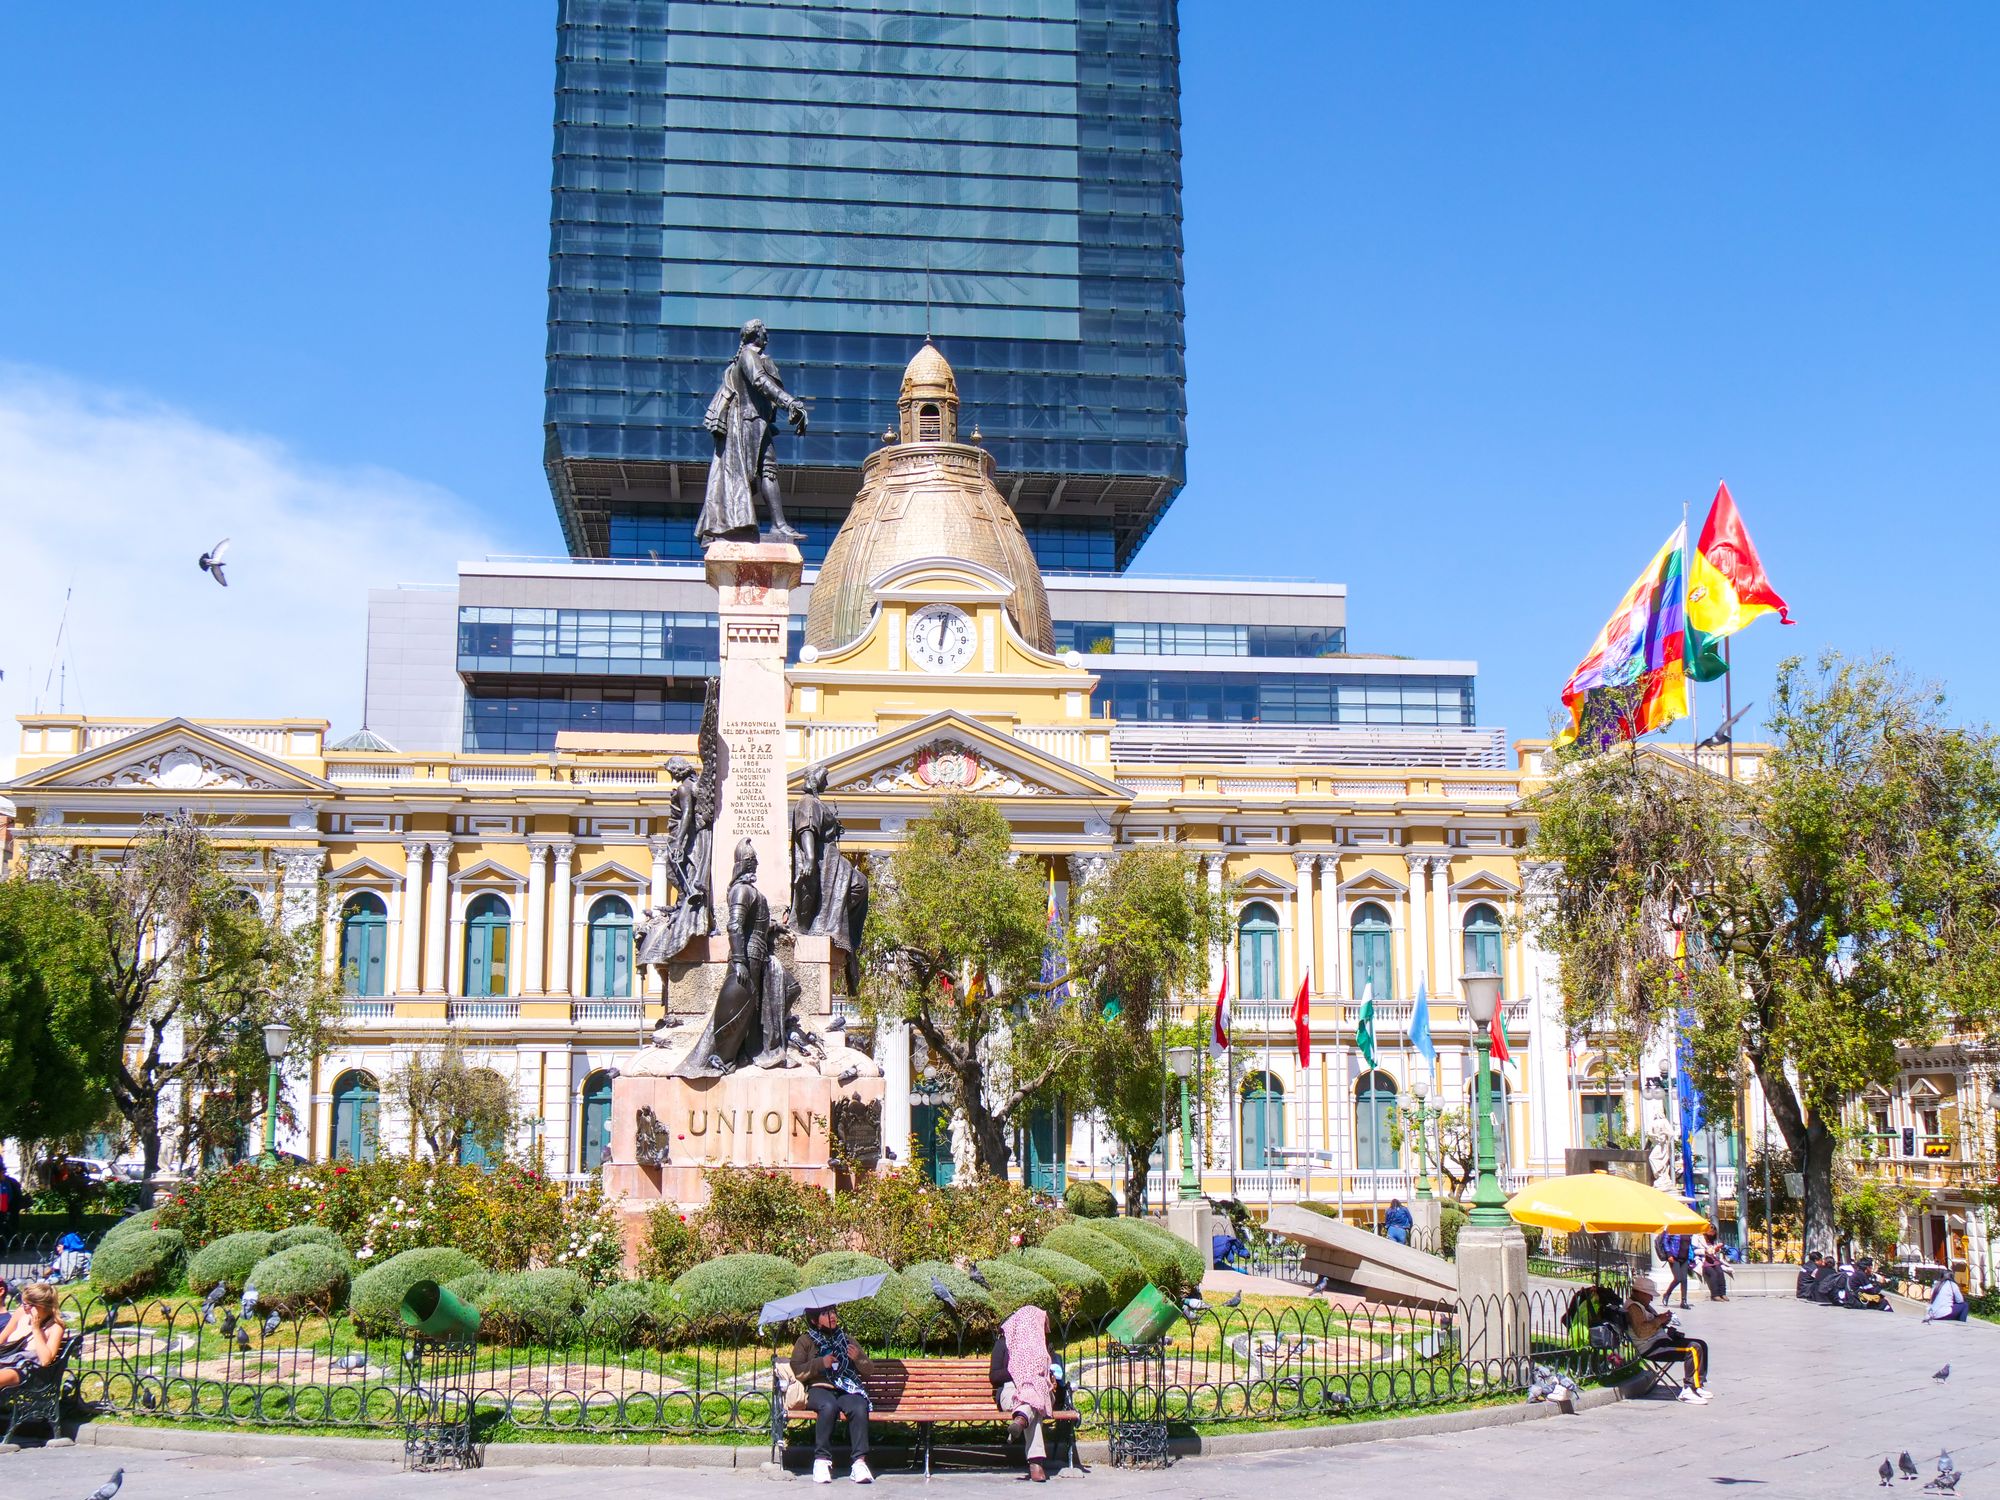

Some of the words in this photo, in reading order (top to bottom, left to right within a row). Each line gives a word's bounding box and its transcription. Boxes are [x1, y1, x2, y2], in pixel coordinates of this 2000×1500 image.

[916, 634, 922, 643] 3
[961, 636, 967, 645] 9
[938, 656, 944, 665] 6
[731, 744, 746, 753] LA
[750, 744, 772, 753] PAZ
[688, 1109, 813, 1137] UNION
